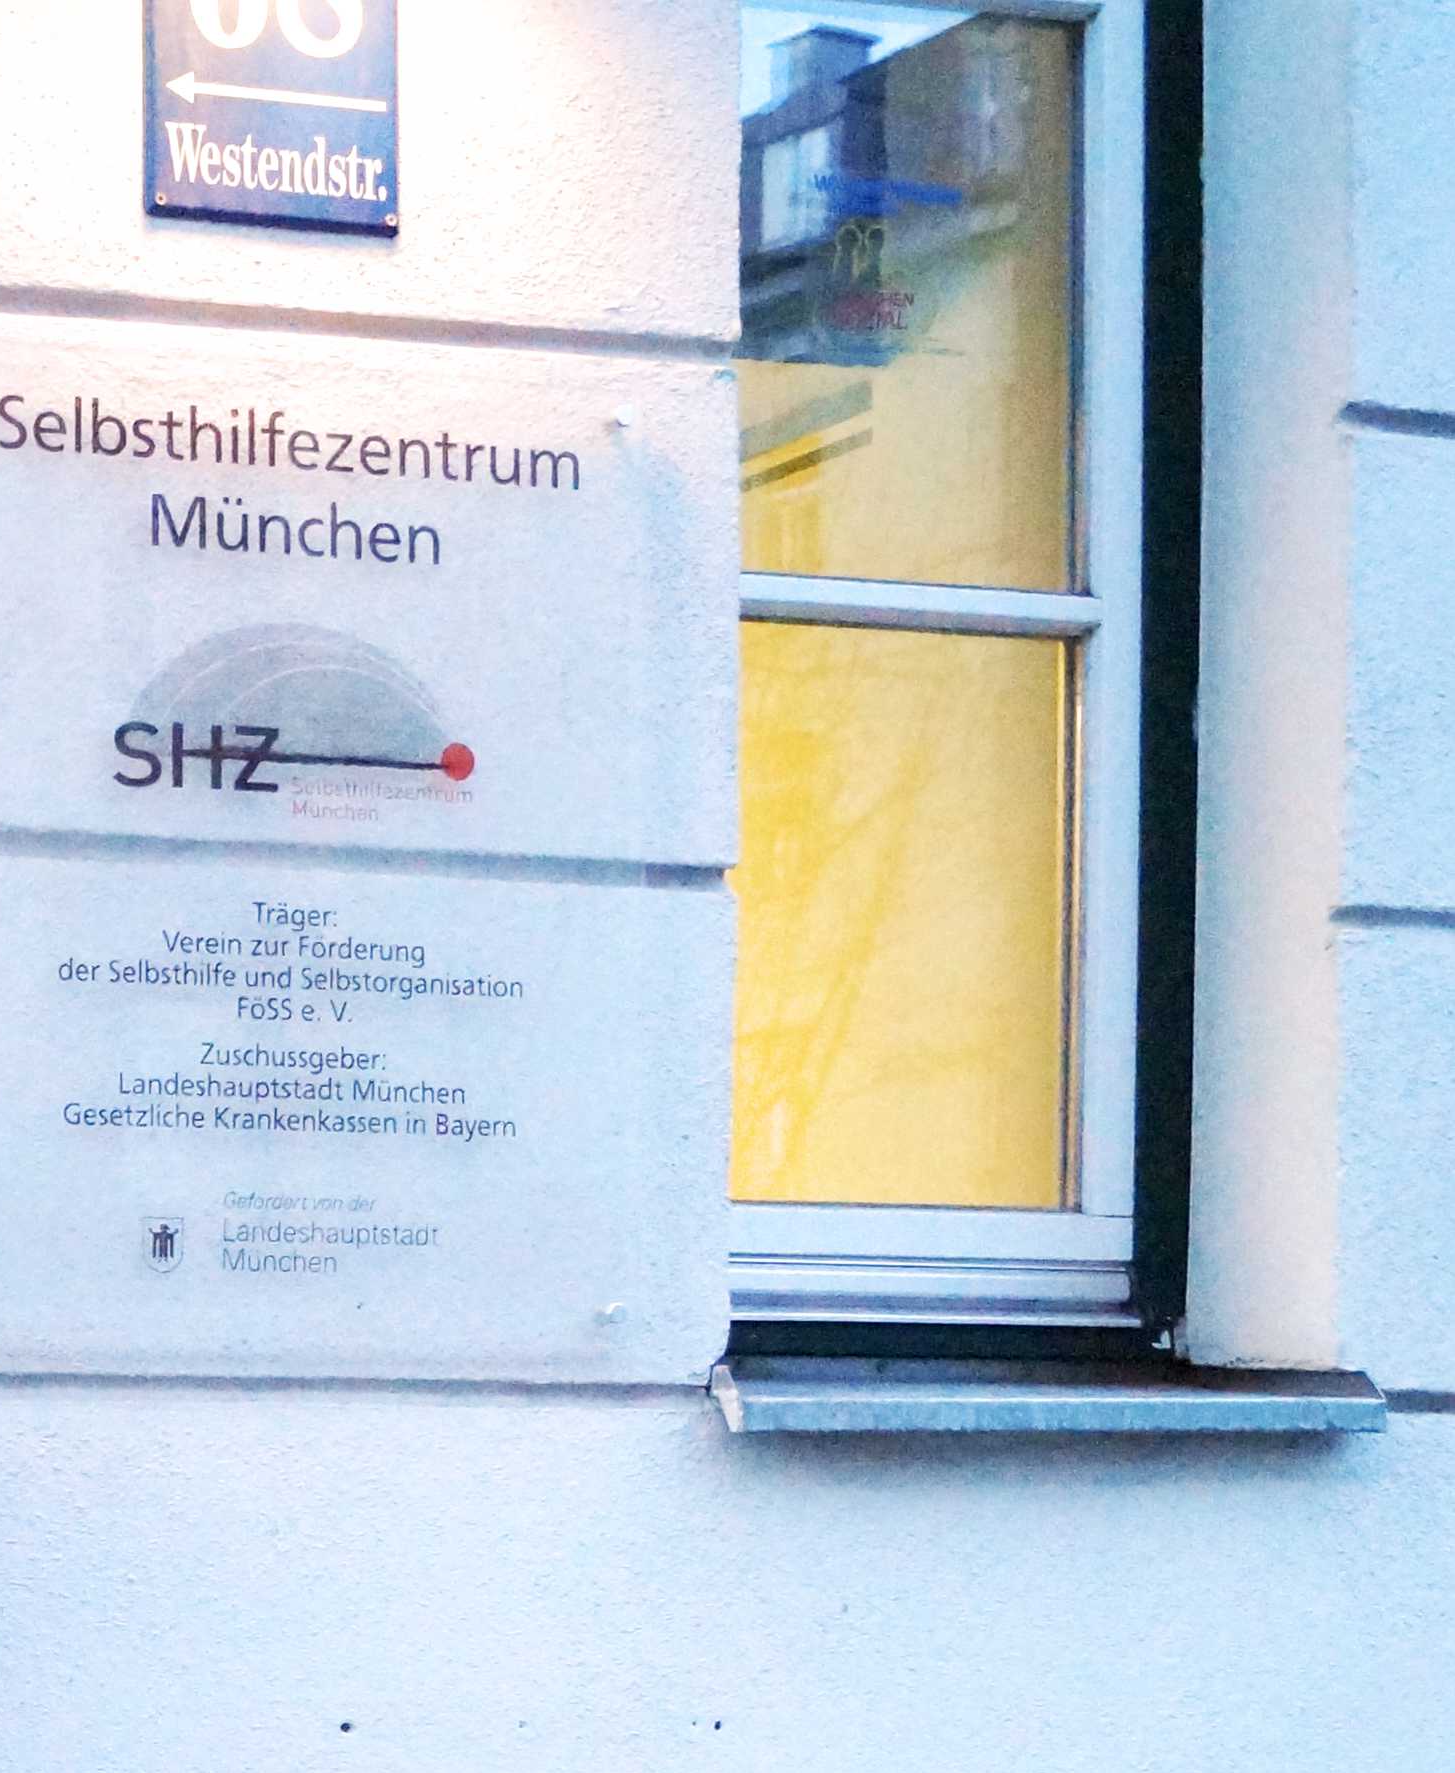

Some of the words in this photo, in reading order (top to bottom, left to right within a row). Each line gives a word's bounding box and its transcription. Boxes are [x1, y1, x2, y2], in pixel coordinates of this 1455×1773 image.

[165, 121, 387, 201] Westendstr.
[150, 492, 441, 565] München
[113, 721, 280, 793] SHZ
[253, 902, 338, 931] Träger:
[162, 930, 242, 956] Verein
[250, 938, 289, 957] zur
[298, 936, 426, 968] Förderung
[59, 960, 99, 982] der
[109, 960, 236, 988] Selbsthilfe
[245, 966, 291, 990] und
[301, 967, 524, 1000] Selbstorganisation
[237, 997, 292, 1021] FöSS
[301, 1005, 322, 1021] e.
[331, 1001, 353, 1023] V.
[200, 1042, 387, 1073] Zuschussgeber:
[119, 1072, 344, 1101] Landeshauptstadt
[353, 1079, 466, 1105] München
[63, 1103, 205, 1129] Gesetzliche
[214, 1105, 397, 1136] Krankenkassen
[406, 1113, 426, 1134] in
[435, 1114, 517, 1142] Bayern
[222, 1219, 439, 1247] Landeshauptstadt
[222, 1249, 338, 1273] München
